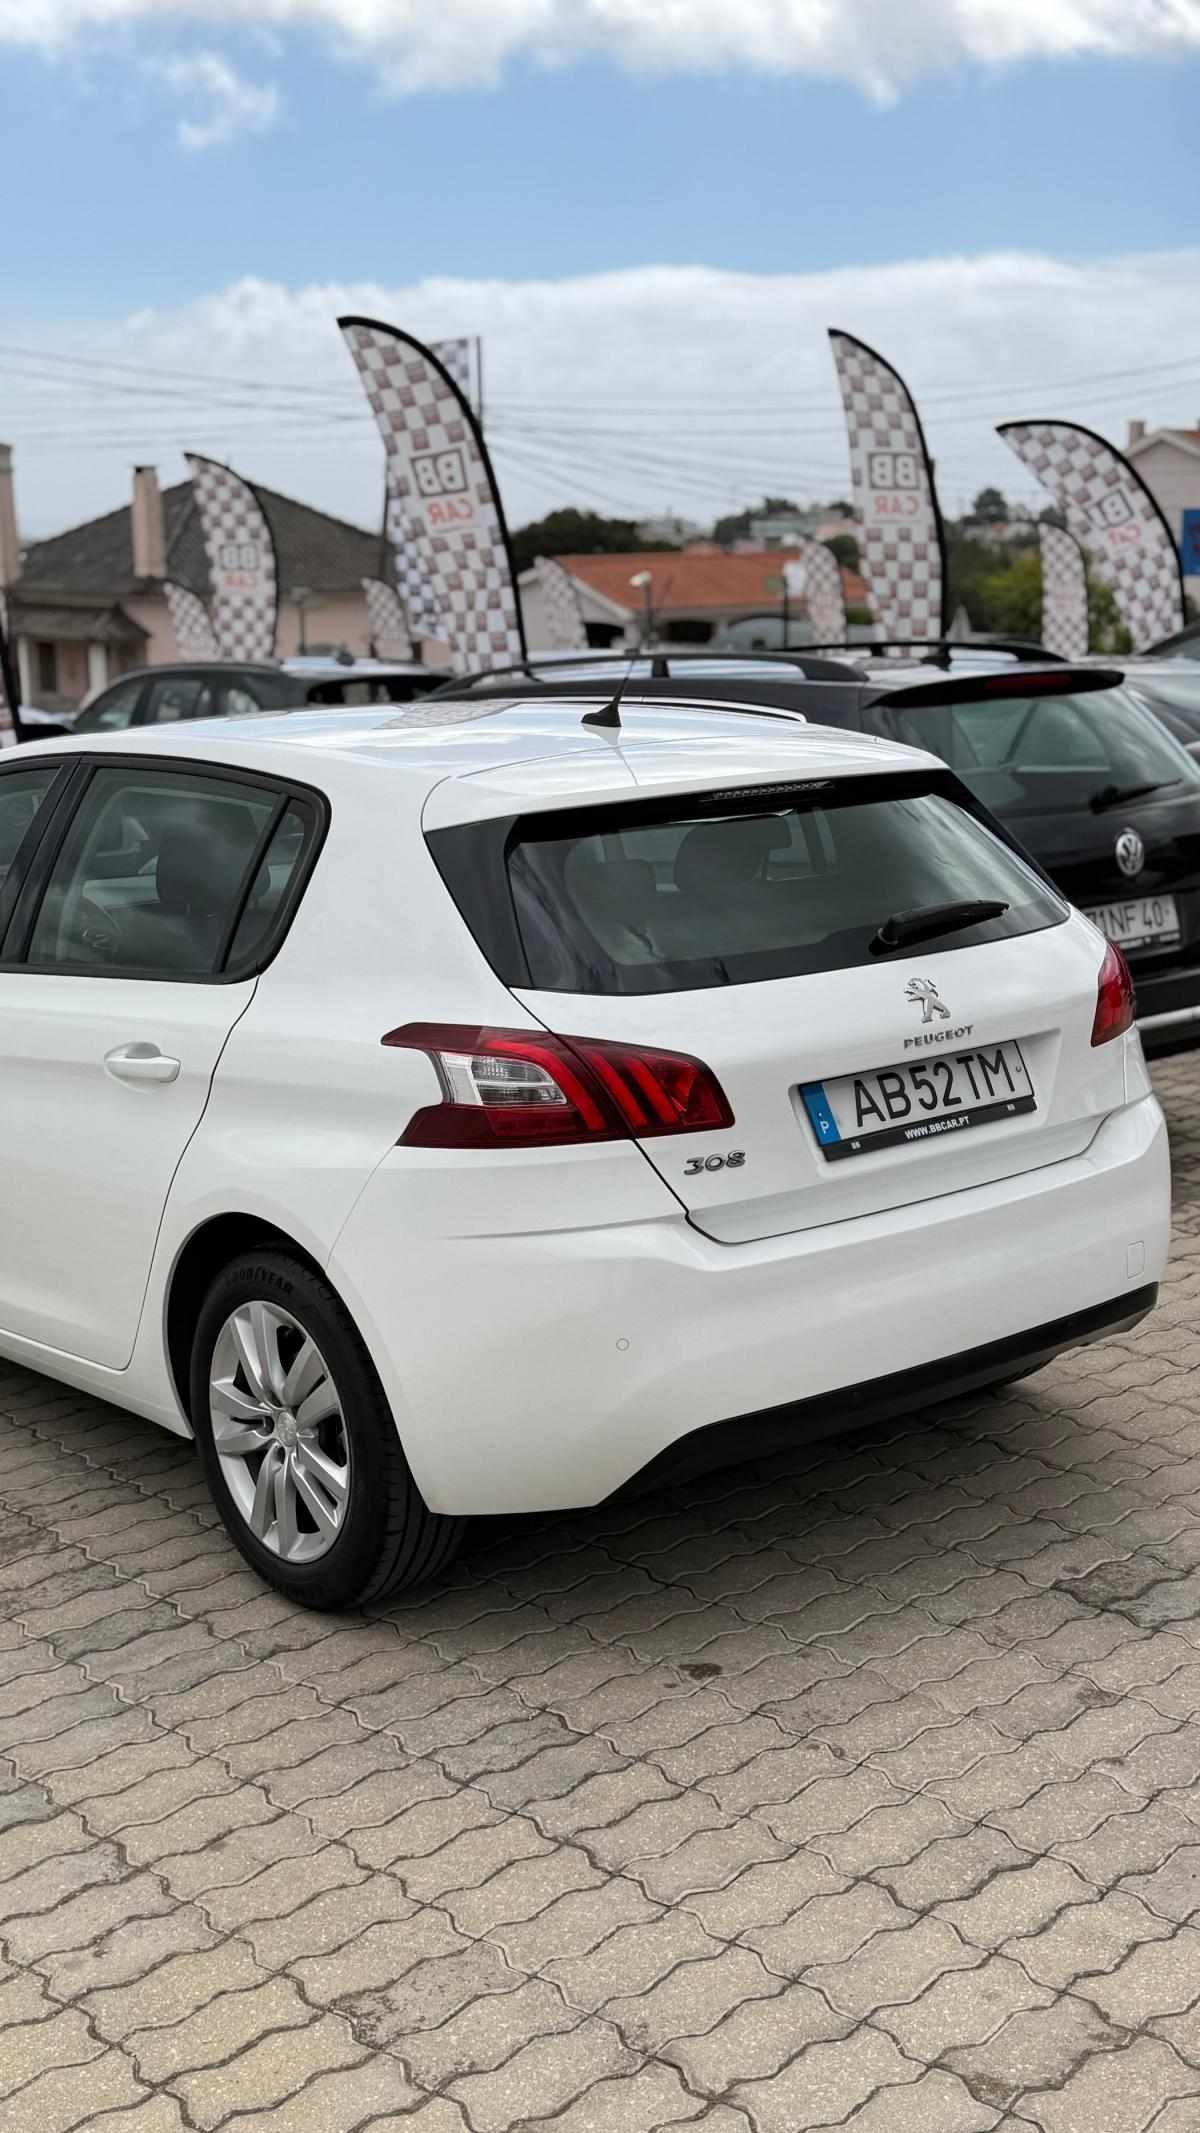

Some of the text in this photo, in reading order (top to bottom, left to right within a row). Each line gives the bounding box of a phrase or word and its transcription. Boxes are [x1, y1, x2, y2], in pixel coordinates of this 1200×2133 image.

[903, 1024, 974, 1050] PEUGEOT
[820, 1120, 830, 1135] P
[904, 1115, 971, 1140] WWW.BBCAR.PT
[684, 1150, 746, 1175] 308
[224, 1264, 295, 1295] ODYEAR
